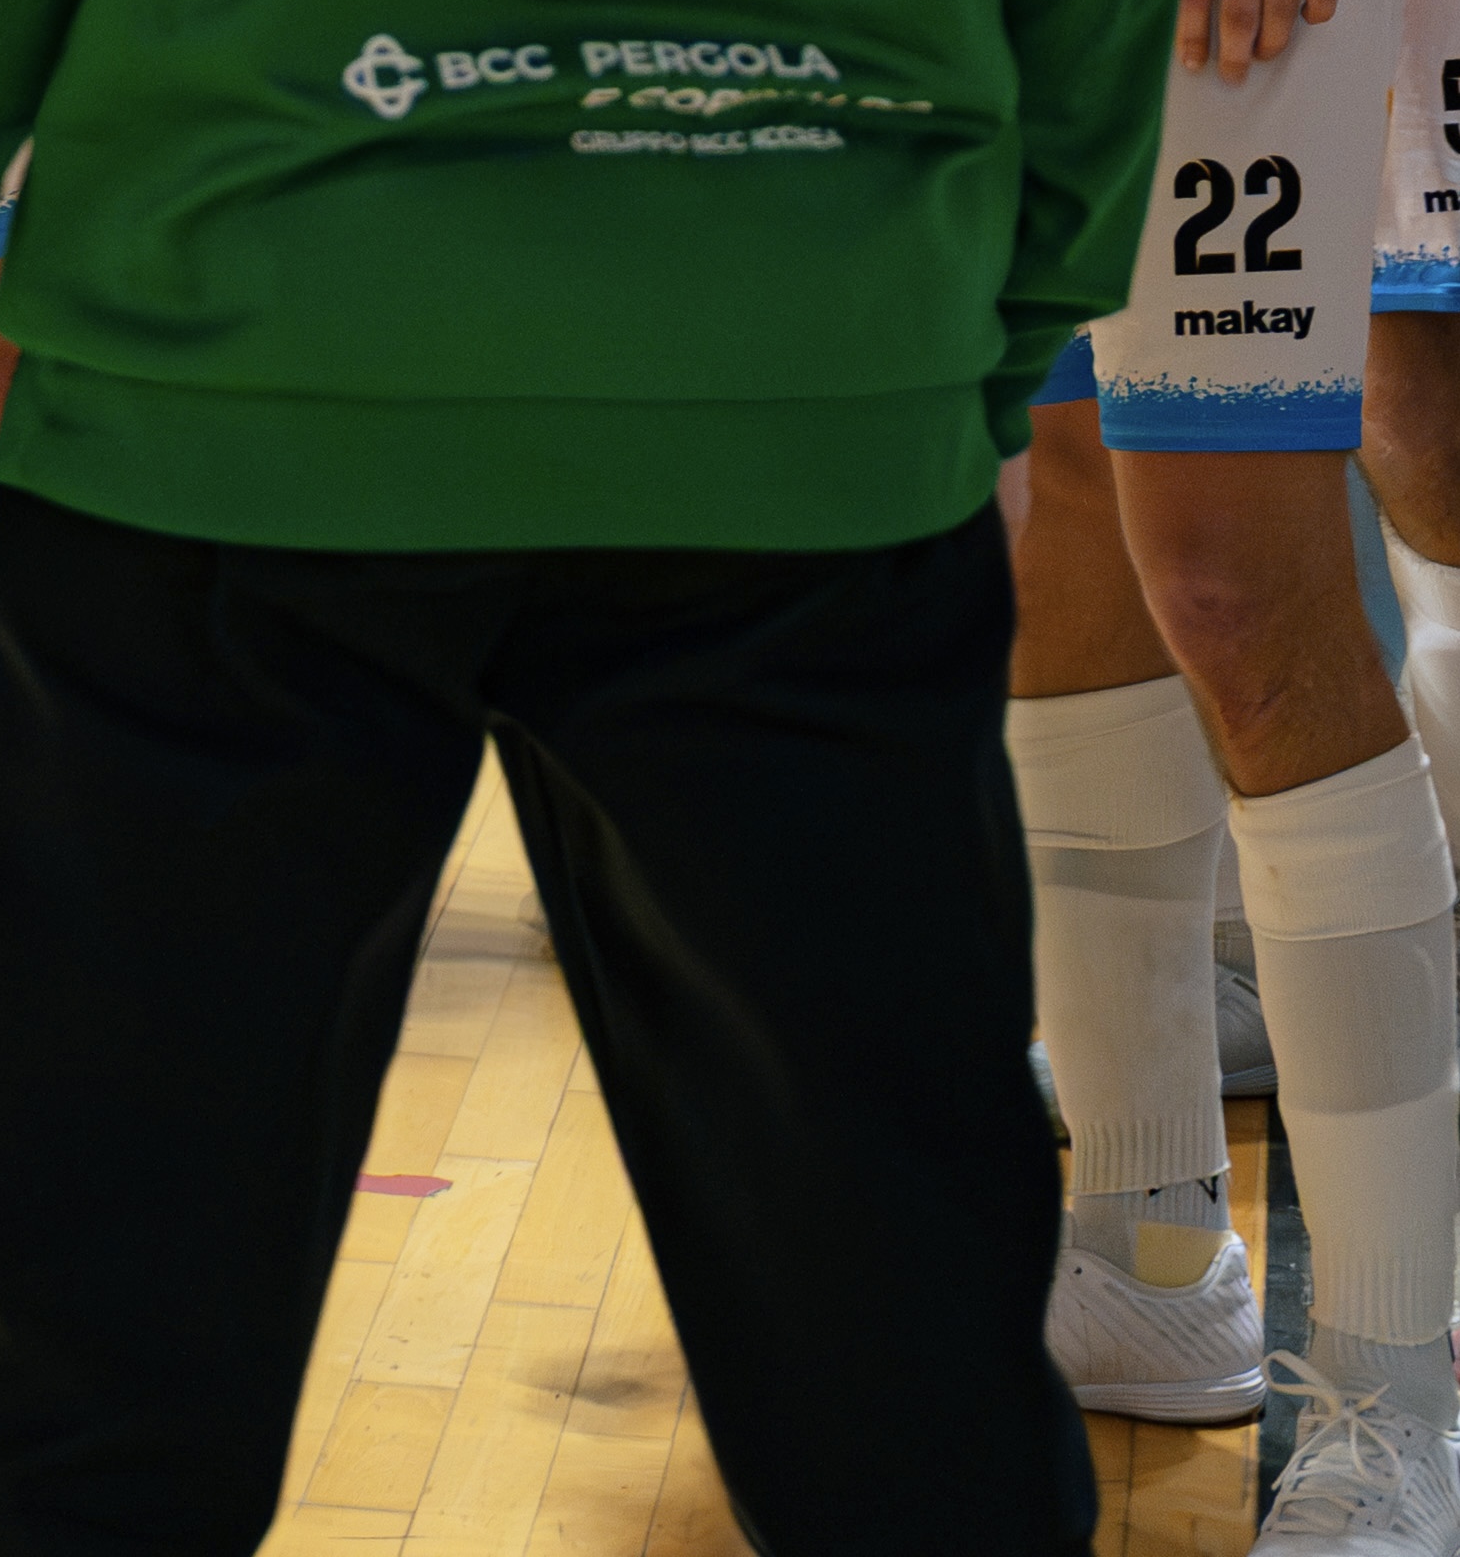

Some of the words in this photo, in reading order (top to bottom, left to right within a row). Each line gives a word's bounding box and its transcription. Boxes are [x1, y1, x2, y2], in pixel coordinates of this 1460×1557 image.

[436, 44, 556, 89] BCC
[580, 40, 840, 82] PERGOLA
[1174, 155, 1302, 276] 22
[1174, 300, 1315, 339] makay
